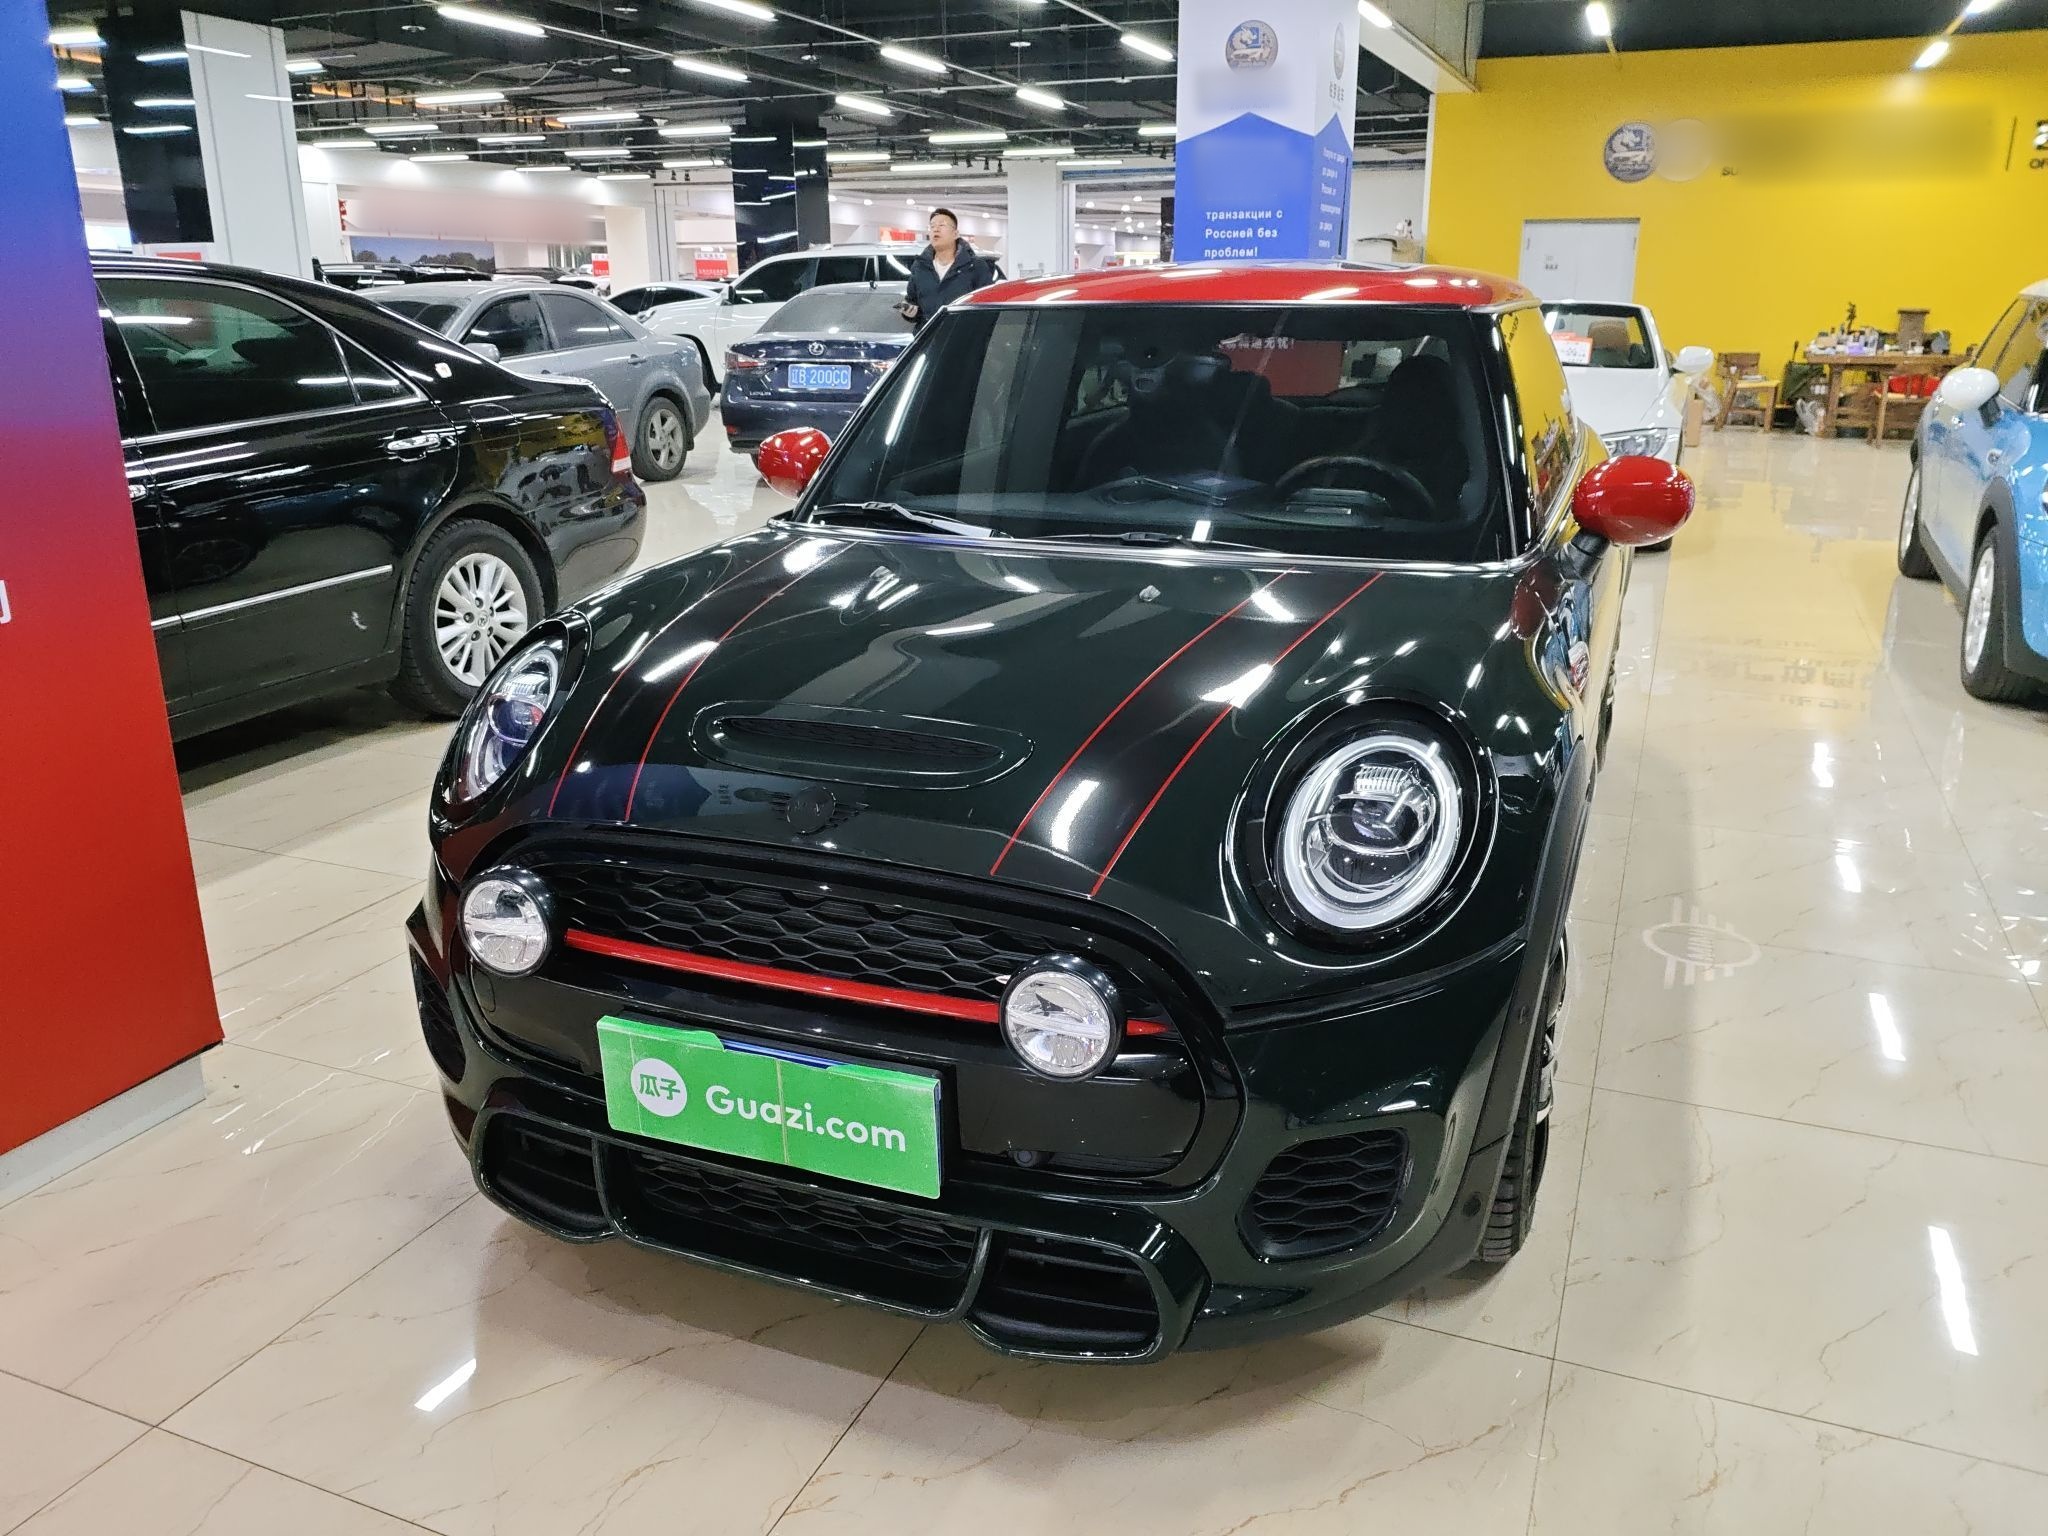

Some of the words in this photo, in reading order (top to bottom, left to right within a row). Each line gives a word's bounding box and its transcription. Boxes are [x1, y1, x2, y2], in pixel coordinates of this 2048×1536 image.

[1205, 210, 1272, 222] транзакции
[1205, 227, 1253, 238] Россией
[1257, 227, 1278, 238] без
[1204, 246, 1258, 258] проблем!
[639, 1073, 681, 1100] 瓜子
[705, 1084, 906, 1153] Guazi.com
